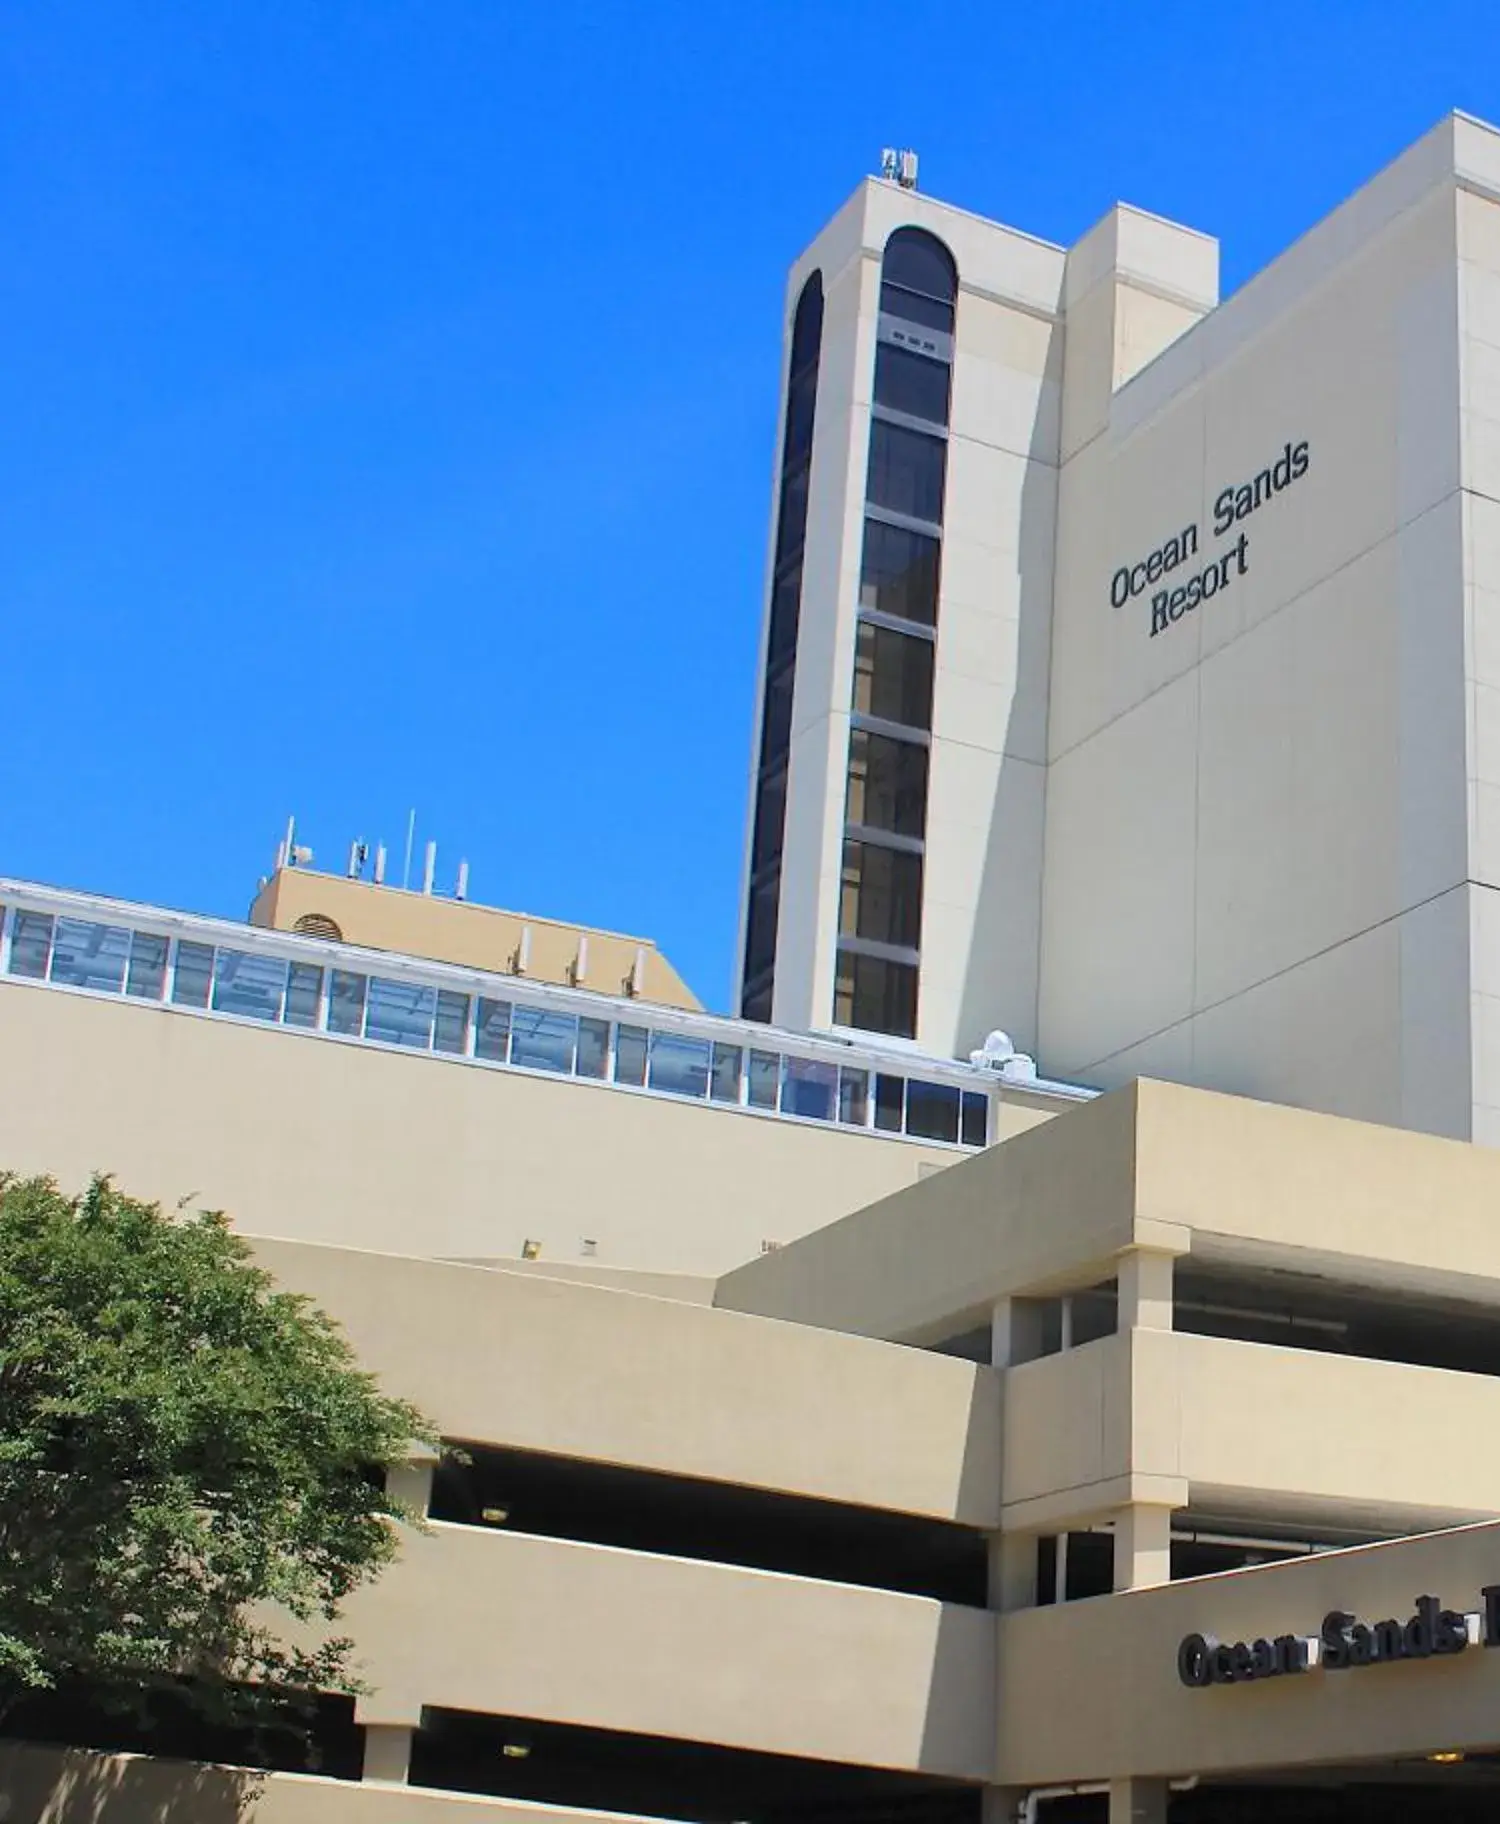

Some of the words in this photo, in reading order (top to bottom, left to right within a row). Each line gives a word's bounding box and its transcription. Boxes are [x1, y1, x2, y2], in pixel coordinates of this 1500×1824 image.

[1110, 522, 1199, 609] Ocean
[1213, 440, 1310, 538] Sands
[1149, 531, 1249, 639] Resort
[1177, 1632, 1311, 1688] Ocean
[1321, 1594, 1470, 1669] Sands
